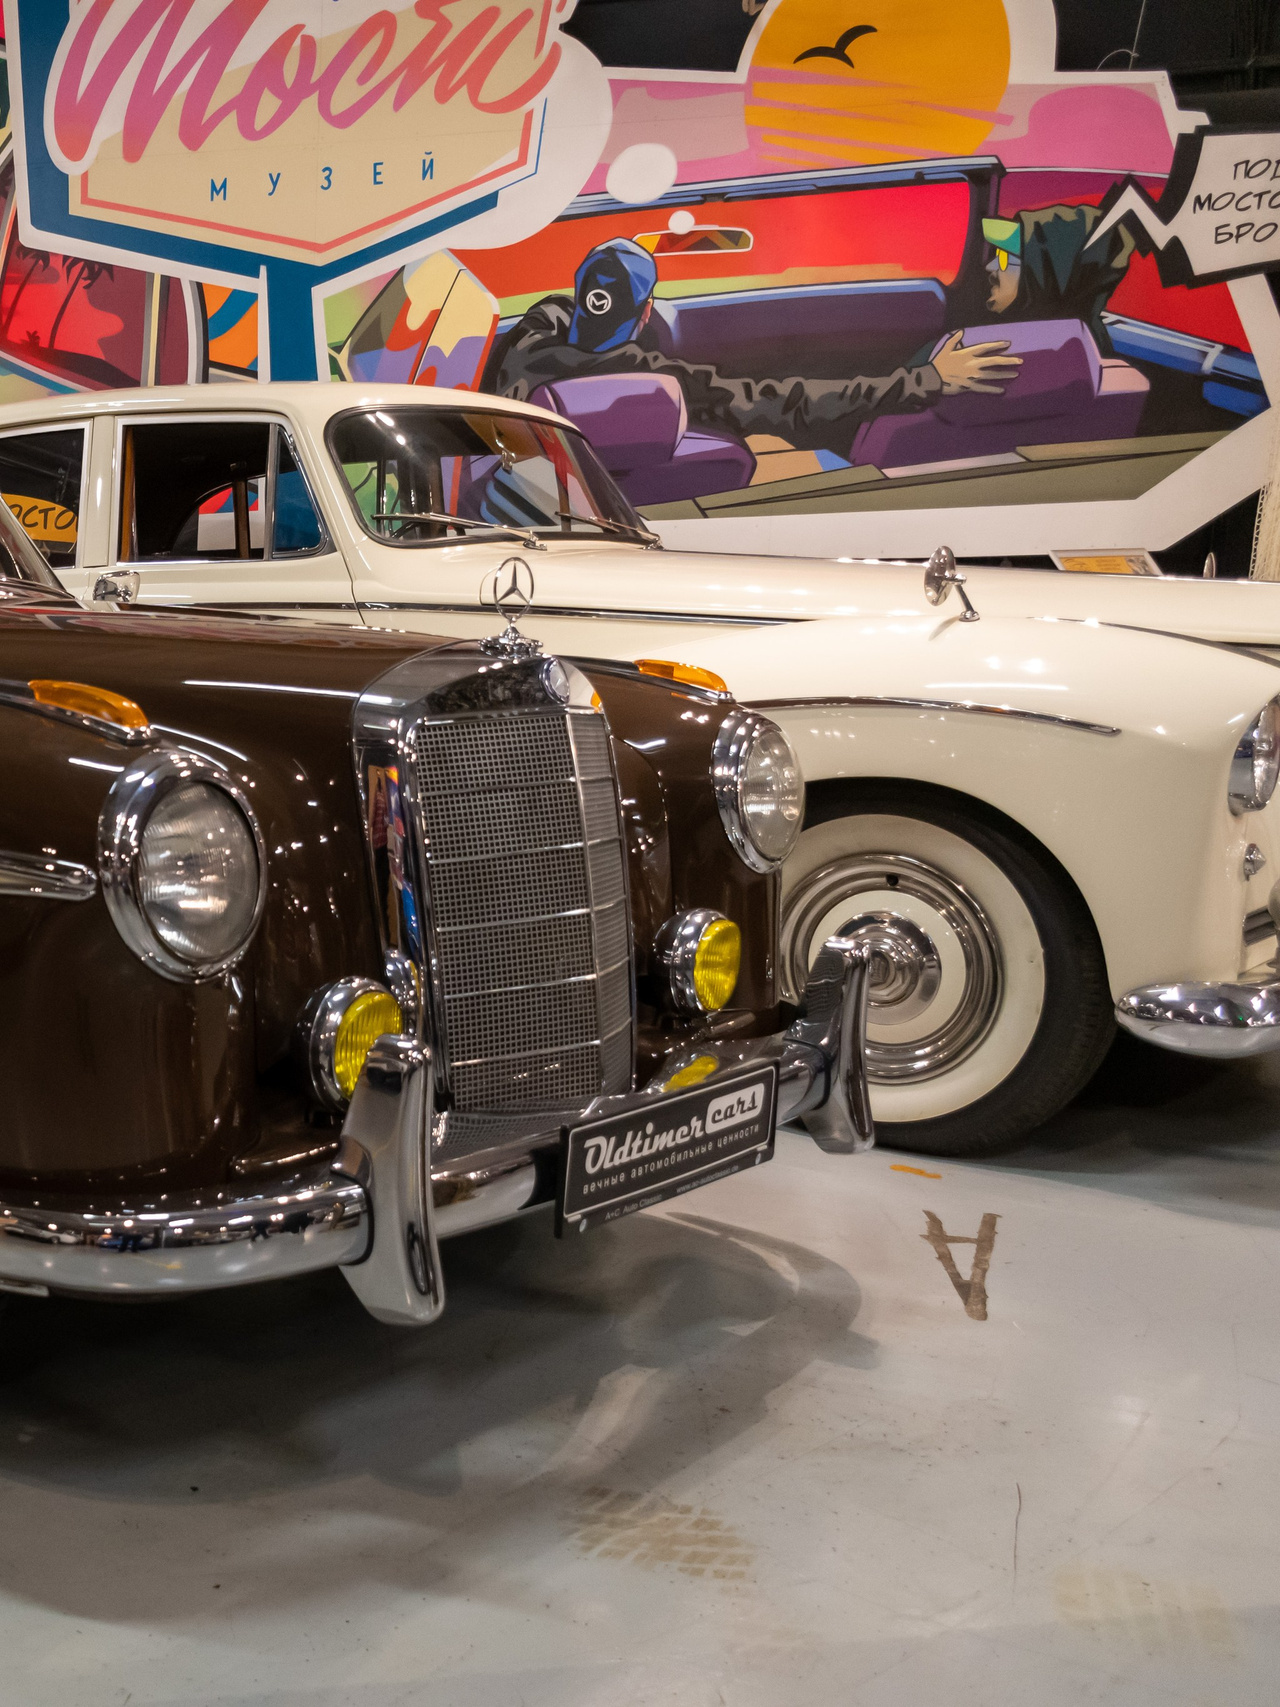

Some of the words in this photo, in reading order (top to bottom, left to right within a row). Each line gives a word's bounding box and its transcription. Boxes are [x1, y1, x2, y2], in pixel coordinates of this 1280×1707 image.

[210, 151, 434, 201] МУЗЕЙ
[582, 1172, 625, 1195] вечные
[630, 1141, 713, 1179] автомобильные
[716, 1123, 760, 1149] ценности
[583, 1116, 705, 1175] Oldtimer
[710, 1090, 759, 1124] cars
